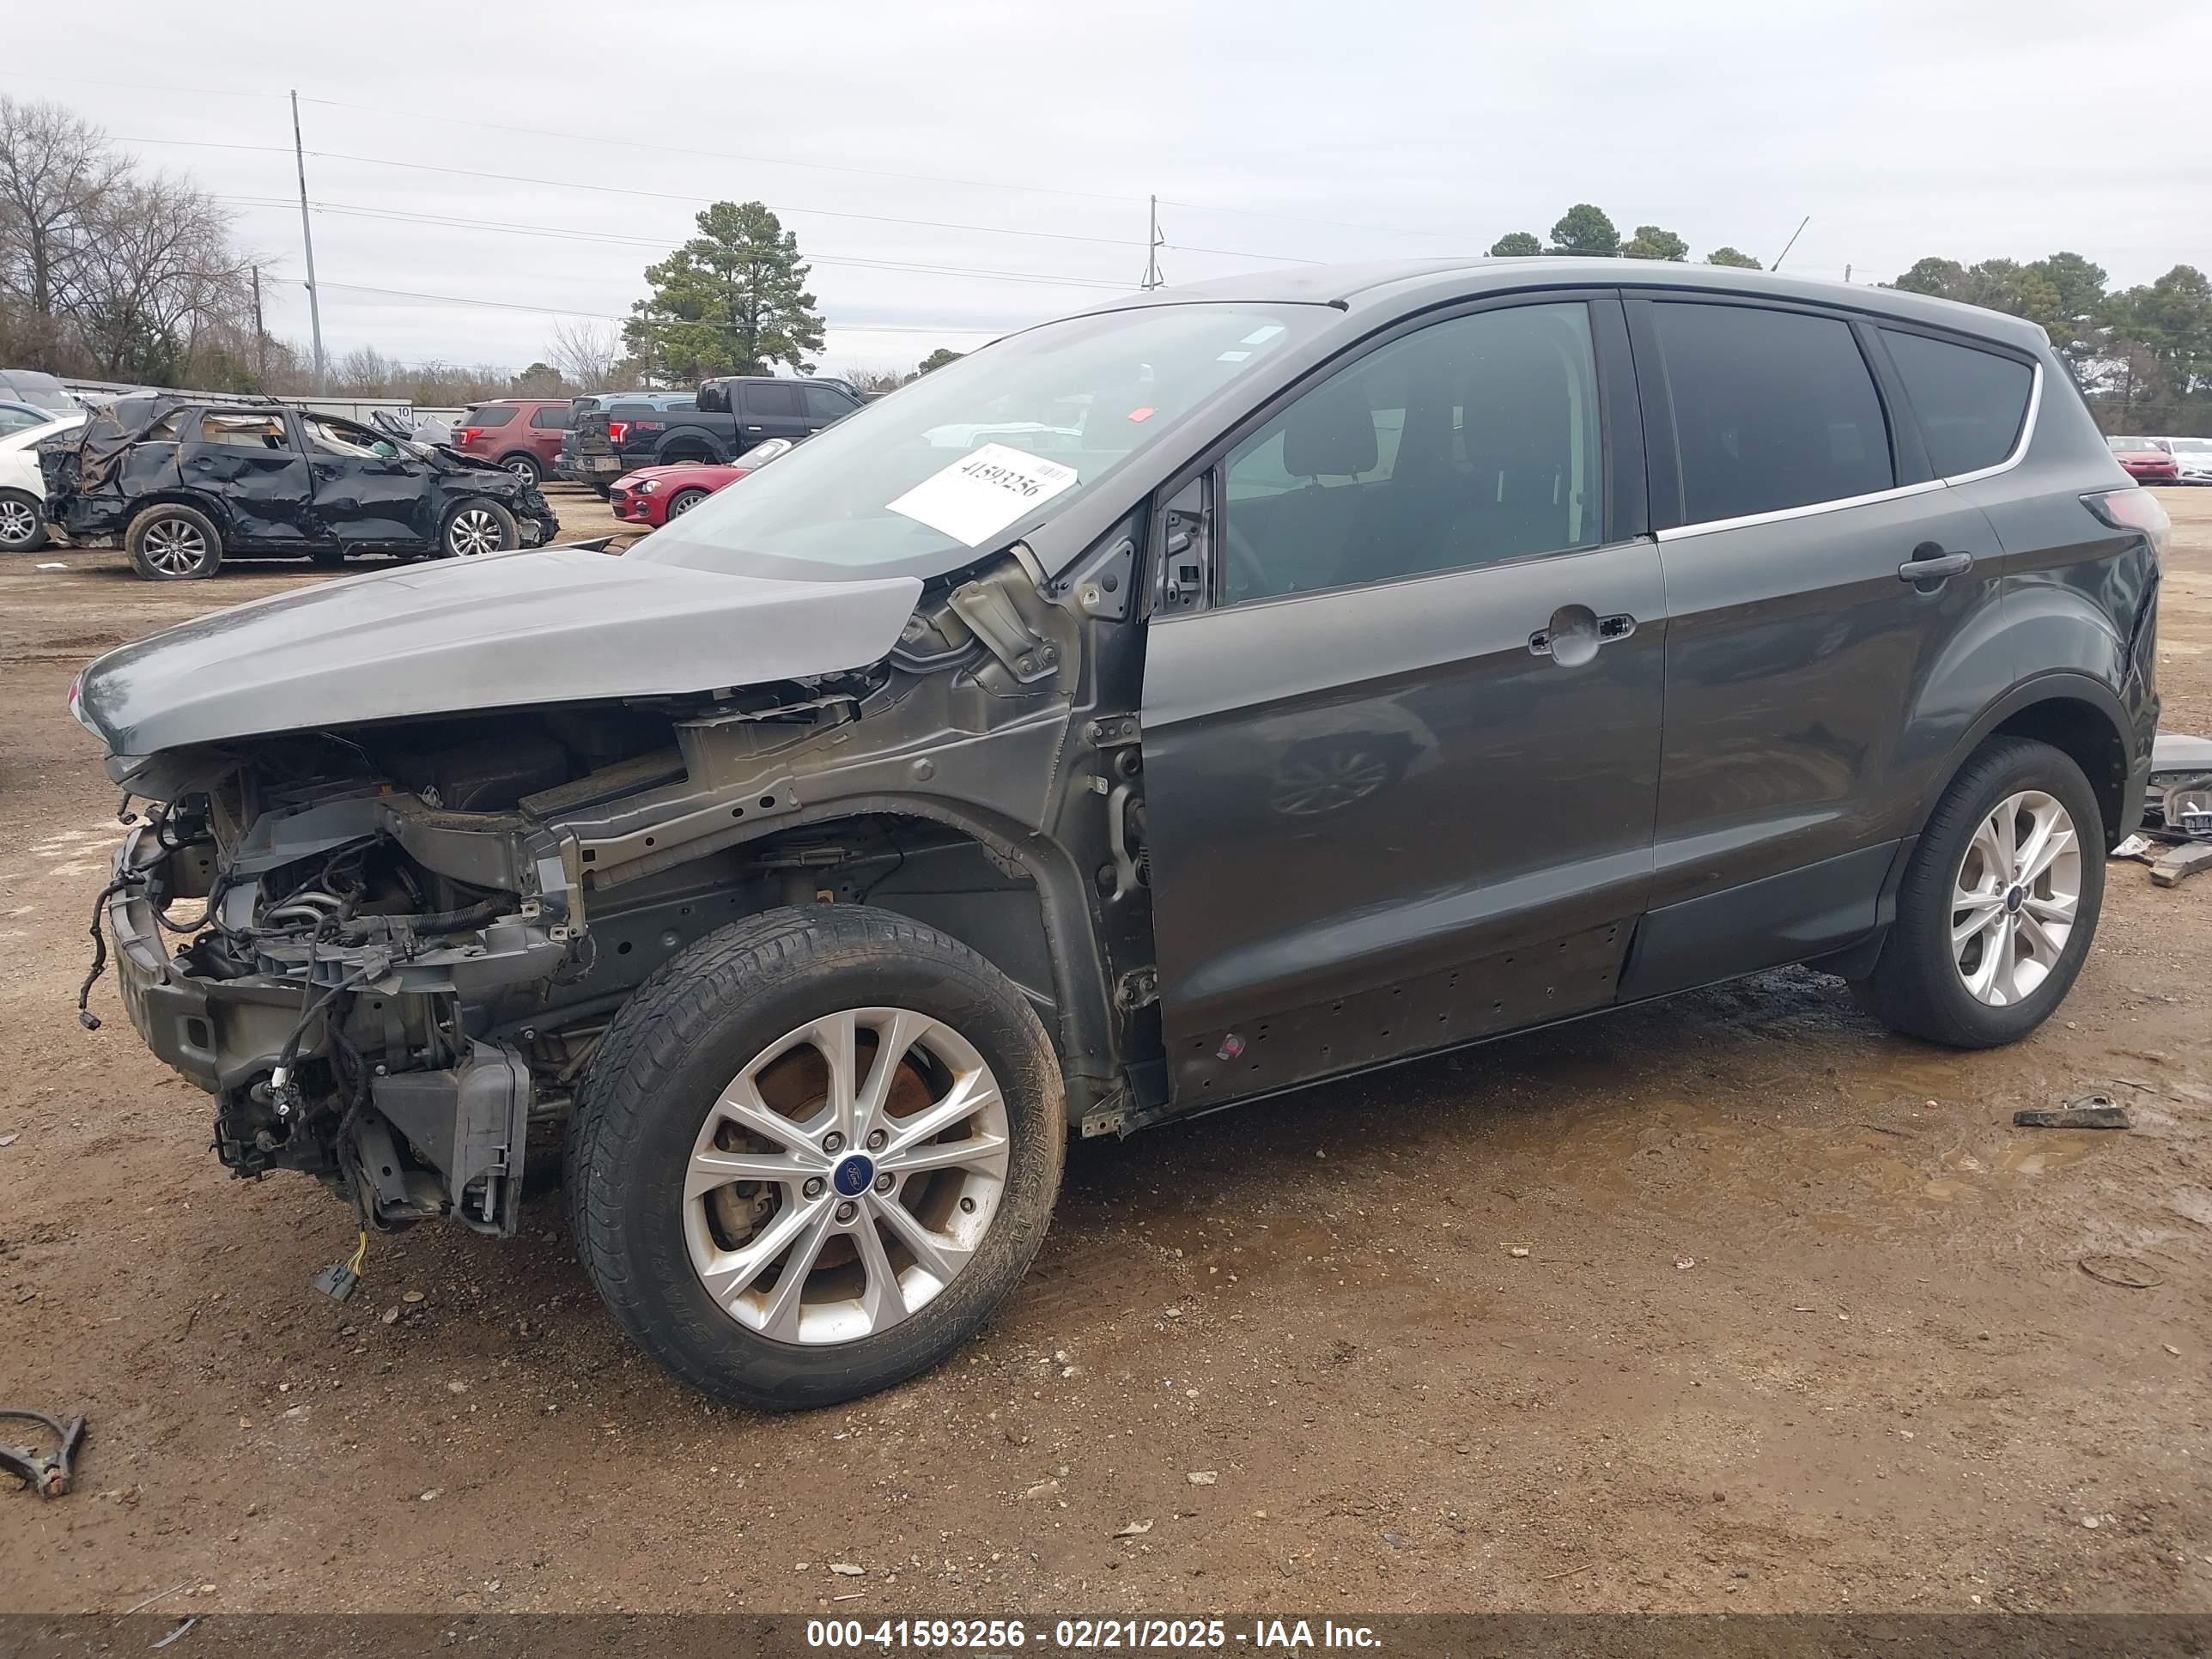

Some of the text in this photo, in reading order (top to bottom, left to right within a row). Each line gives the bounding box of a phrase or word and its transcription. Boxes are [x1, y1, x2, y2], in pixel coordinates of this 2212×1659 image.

[397, 407, 410, 417] 10
[961, 460, 1046, 497] 41593256
[848, 1166, 860, 1187] Ford
